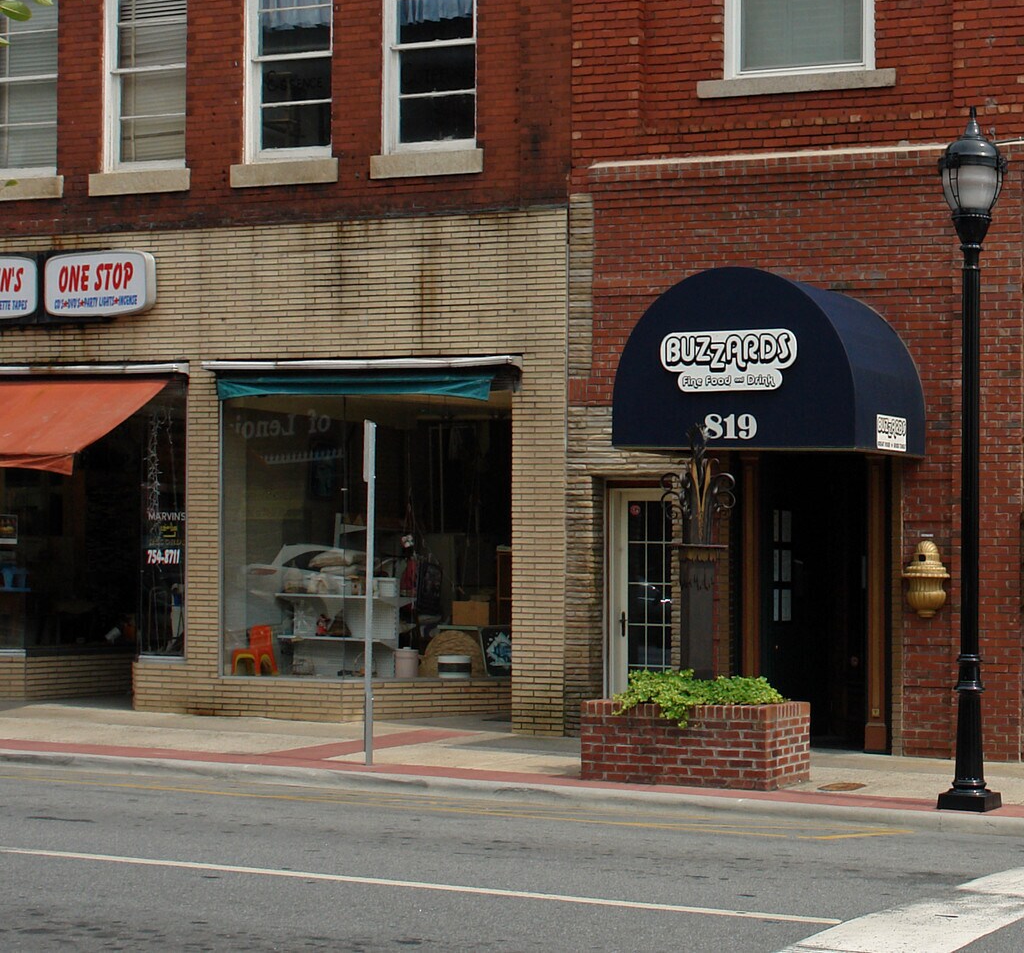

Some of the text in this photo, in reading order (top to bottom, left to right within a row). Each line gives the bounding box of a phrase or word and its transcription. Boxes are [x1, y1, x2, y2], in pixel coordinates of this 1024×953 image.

[0, 267, 24, 292] N'S
[58, 261, 134, 293] ONE STOP
[12, 300, 28, 310] TAPES
[84, 297, 98, 307] PARTY
[98, 296, 115, 307] LIGHTS
[118, 294, 138, 306] INCENSE
[665, 332, 793, 372] BUZZARDS
[705, 375, 731, 387] Food
[746, 374, 776, 388] Drink
[704, 413, 758, 440] 819
[147, 549, 181, 564] 754-8711
